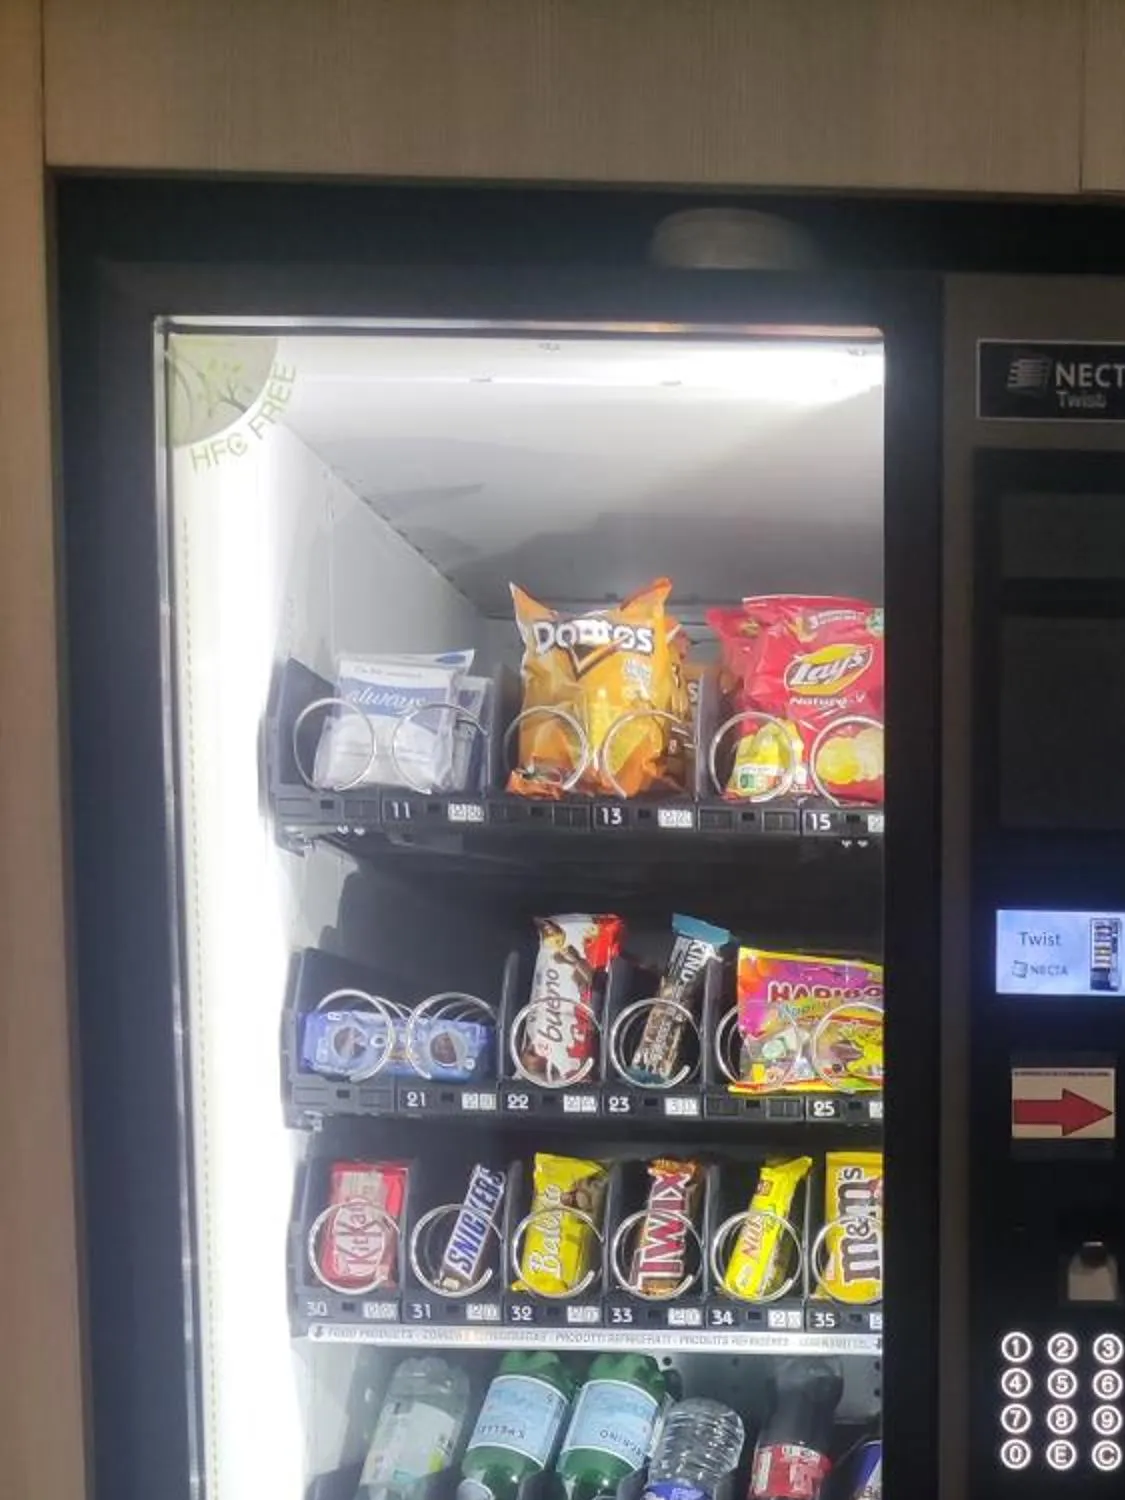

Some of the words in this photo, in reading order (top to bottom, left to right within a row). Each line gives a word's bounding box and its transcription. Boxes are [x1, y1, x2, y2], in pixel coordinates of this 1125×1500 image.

[247, 362, 298, 440] FREE
[1055, 389, 1108, 409] Twist
[391, 801, 411, 819] 11
[602, 803, 623, 825] 13
[810, 813, 832, 831] 15
[1019, 931, 1062, 947] Twist
[539, 967, 564, 1043] bueno
[406, 1091, 427, 1107] 21
[506, 1093, 529, 1109] 22
[608, 1096, 631, 1113] 23
[812, 1100, 836, 1117] 25
[447, 1167, 506, 1272] SNICKERS
[633, 1170, 690, 1281] TWIX
[306, 1302, 328, 1316] 30
[412, 1303, 431, 1319] 31
[511, 1305, 533, 1321] 32
[611, 1307, 633, 1323] 33
[711, 1309, 734, 1326] 34
[813, 1312, 836, 1329] 35
[1011, 1338, 1019, 1356] 1
[1056, 1339, 1068, 1357] 2
[1102, 1339, 1114, 1358] 3
[1009, 1374, 1022, 1391] 4
[1055, 1374, 1068, 1393] 5
[1101, 1375, 1114, 1394] 6
[1010, 1409, 1021, 1427] 7
[1055, 1410, 1068, 1428] 8
[1101, 1410, 1114, 1429] 9
[1009, 1445, 1022, 1463] 0
[1054, 1446, 1067, 1463] E
[1098, 1446, 1115, 1465] C
